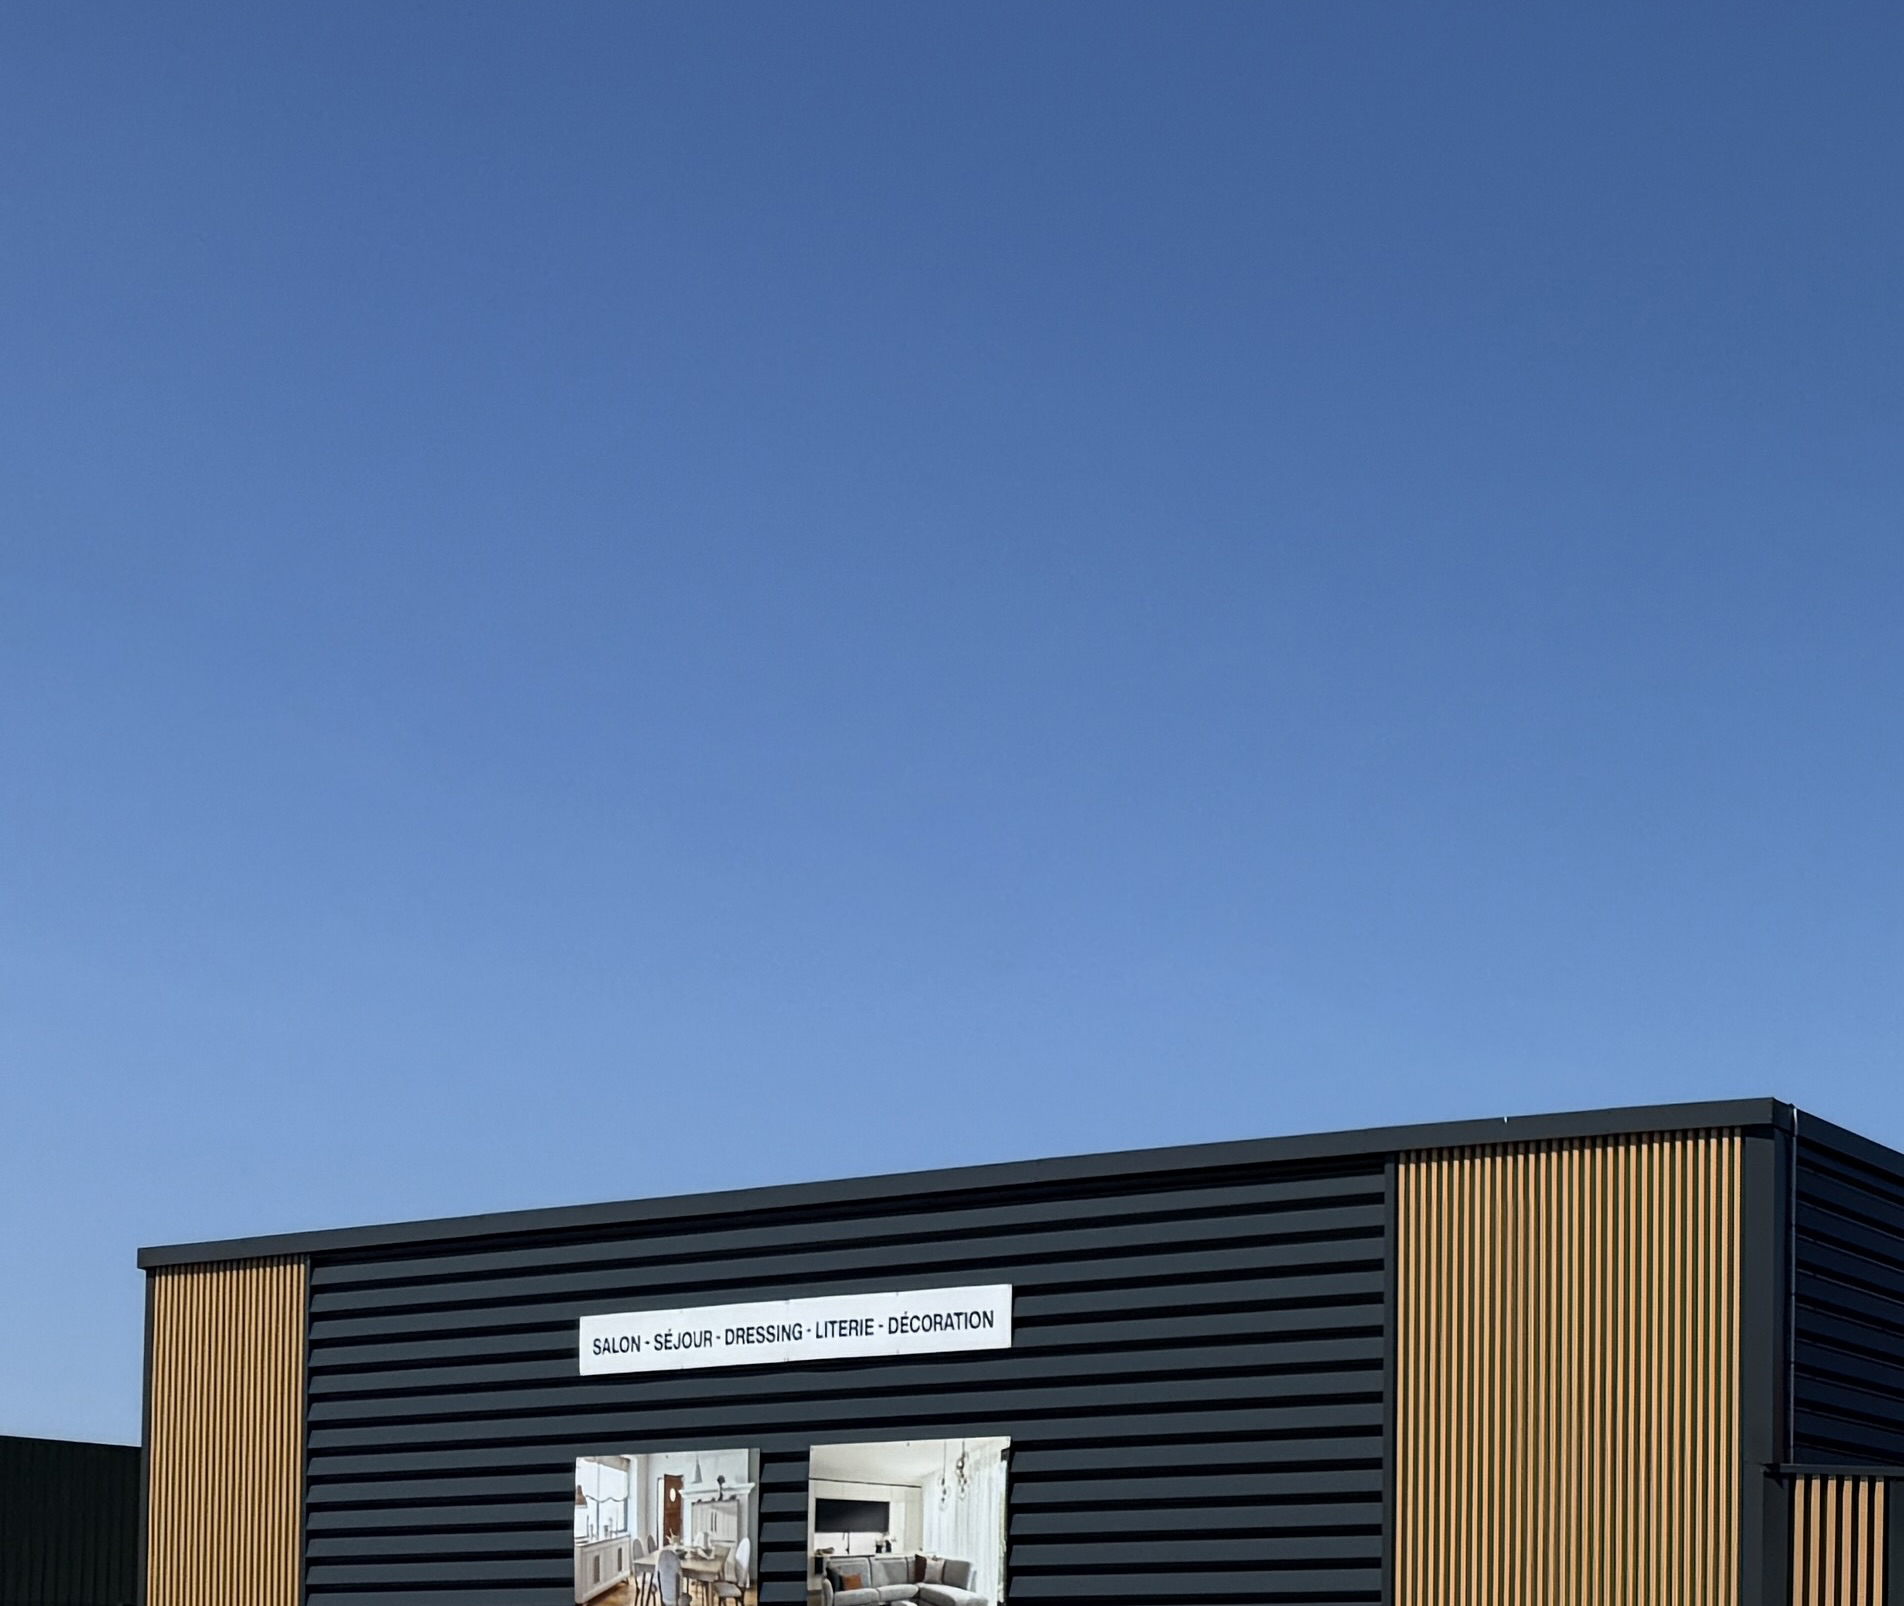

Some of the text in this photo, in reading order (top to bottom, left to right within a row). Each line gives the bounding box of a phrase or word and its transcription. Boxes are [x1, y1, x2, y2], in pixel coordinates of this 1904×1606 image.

[592, 1335, 641, 1356] SALON
[654, 1328, 713, 1351] SÉJOUR
[725, 1322, 803, 1346] DRESSING
[815, 1318, 875, 1339] LITERIE
[888, 1310, 994, 1335] DÉCORATION
